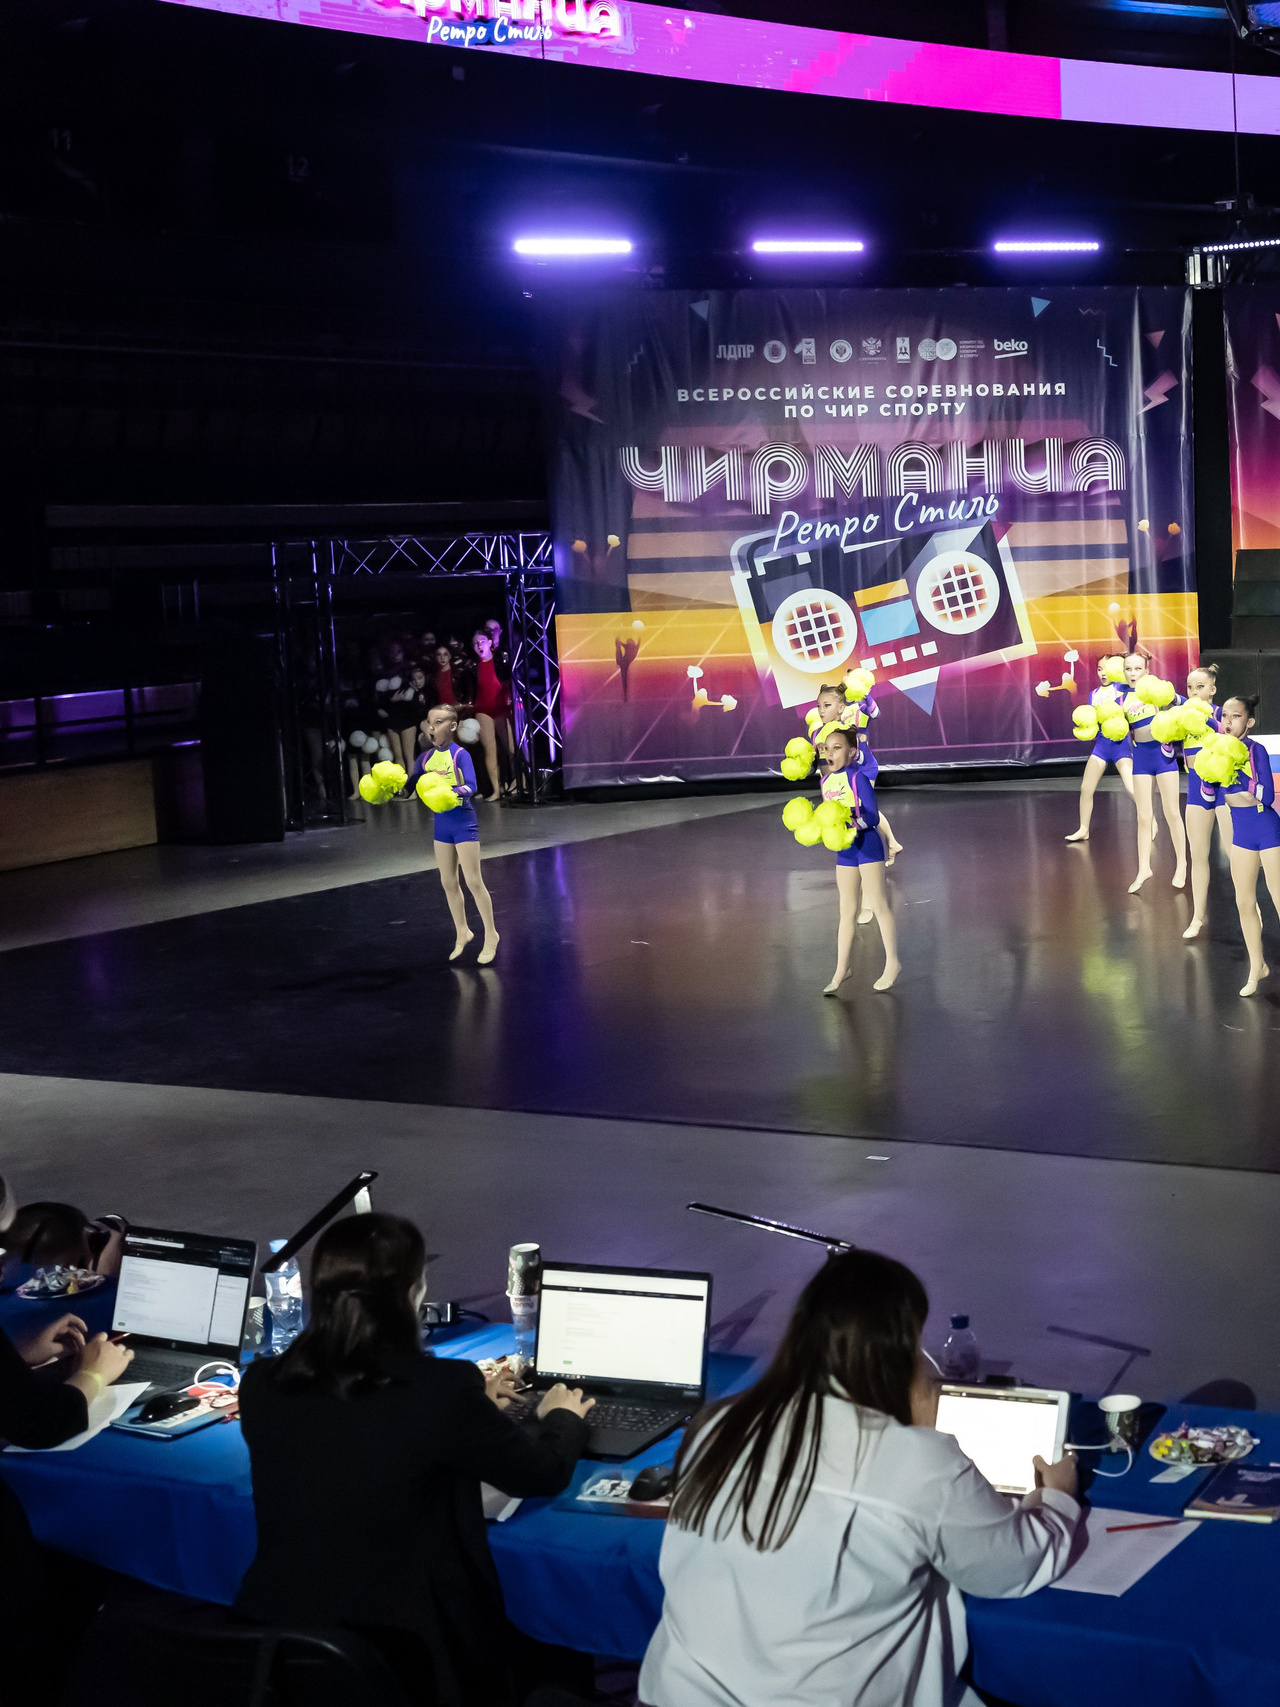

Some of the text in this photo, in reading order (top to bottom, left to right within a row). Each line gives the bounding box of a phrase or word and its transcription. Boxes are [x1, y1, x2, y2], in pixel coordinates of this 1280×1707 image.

[427, 16, 487, 47] Ретро
[716, 344, 755, 360] ЛДПР
[994, 338, 1028, 352] beko
[677, 382, 1067, 401] ВСЕРОССИЙСКИЕ СОРЕВНОВАНИЯ
[784, 402, 966, 418] ПО ЧИР СПОРТУ
[774, 492, 1000, 552] Ретро Стиль
